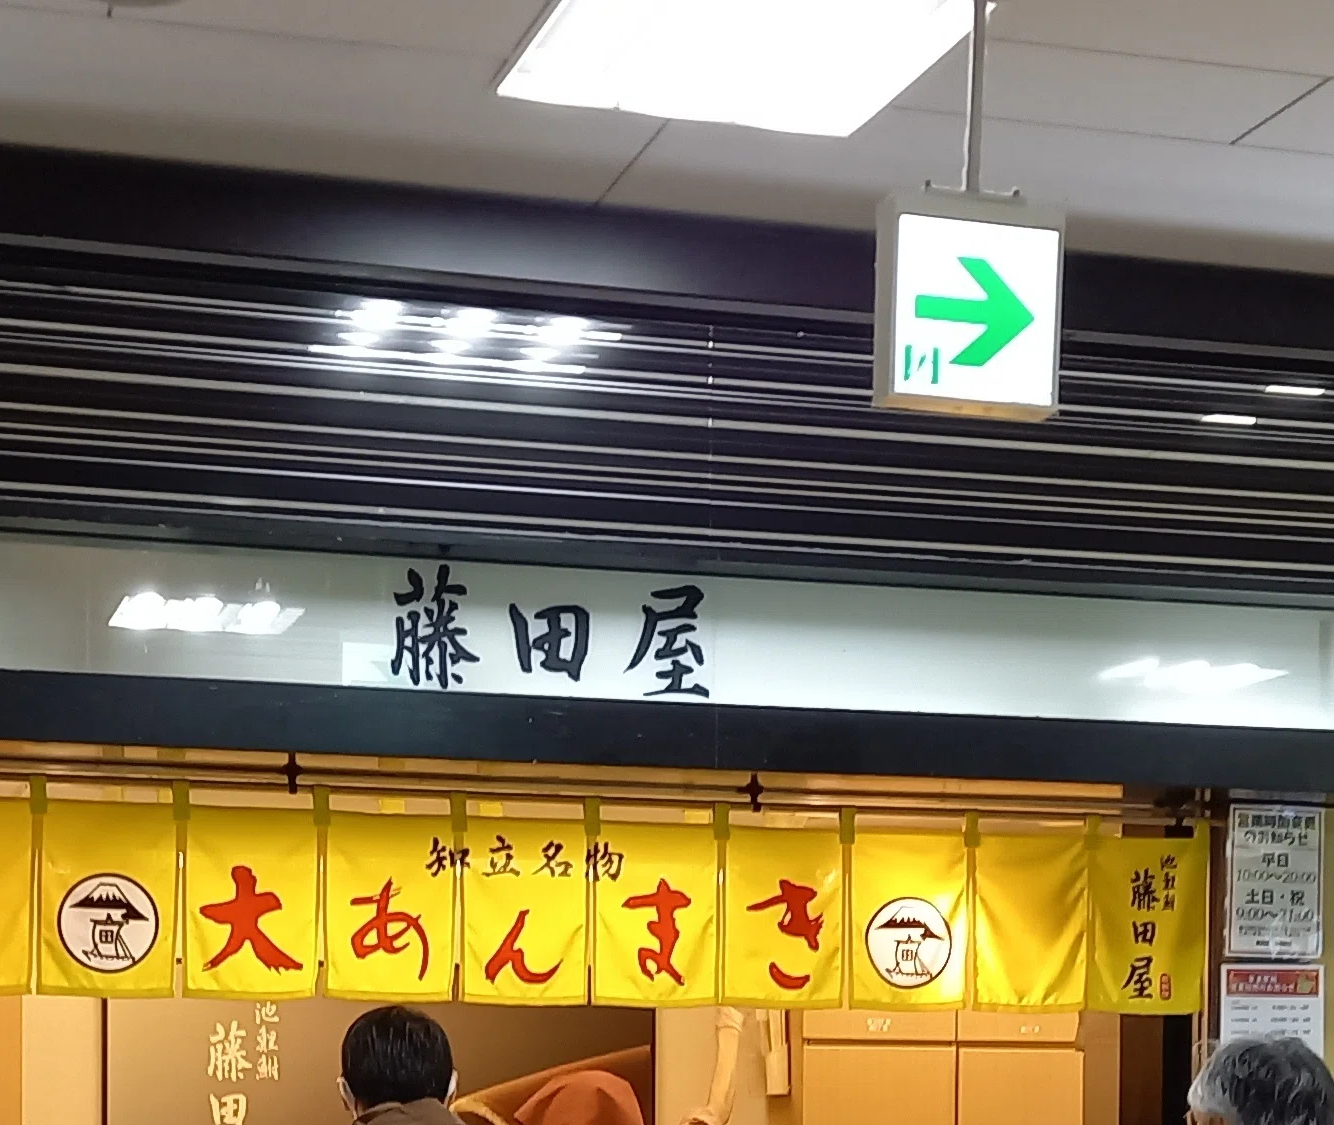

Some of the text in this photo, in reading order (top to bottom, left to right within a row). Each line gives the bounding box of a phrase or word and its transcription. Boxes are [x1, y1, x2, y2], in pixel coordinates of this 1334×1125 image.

[391, 564, 710, 698] 藤田屋
[425, 834, 625, 883] 知立名物
[1261, 853, 1289, 868] 平日
[1121, 867, 1160, 1000] 藤田屋
